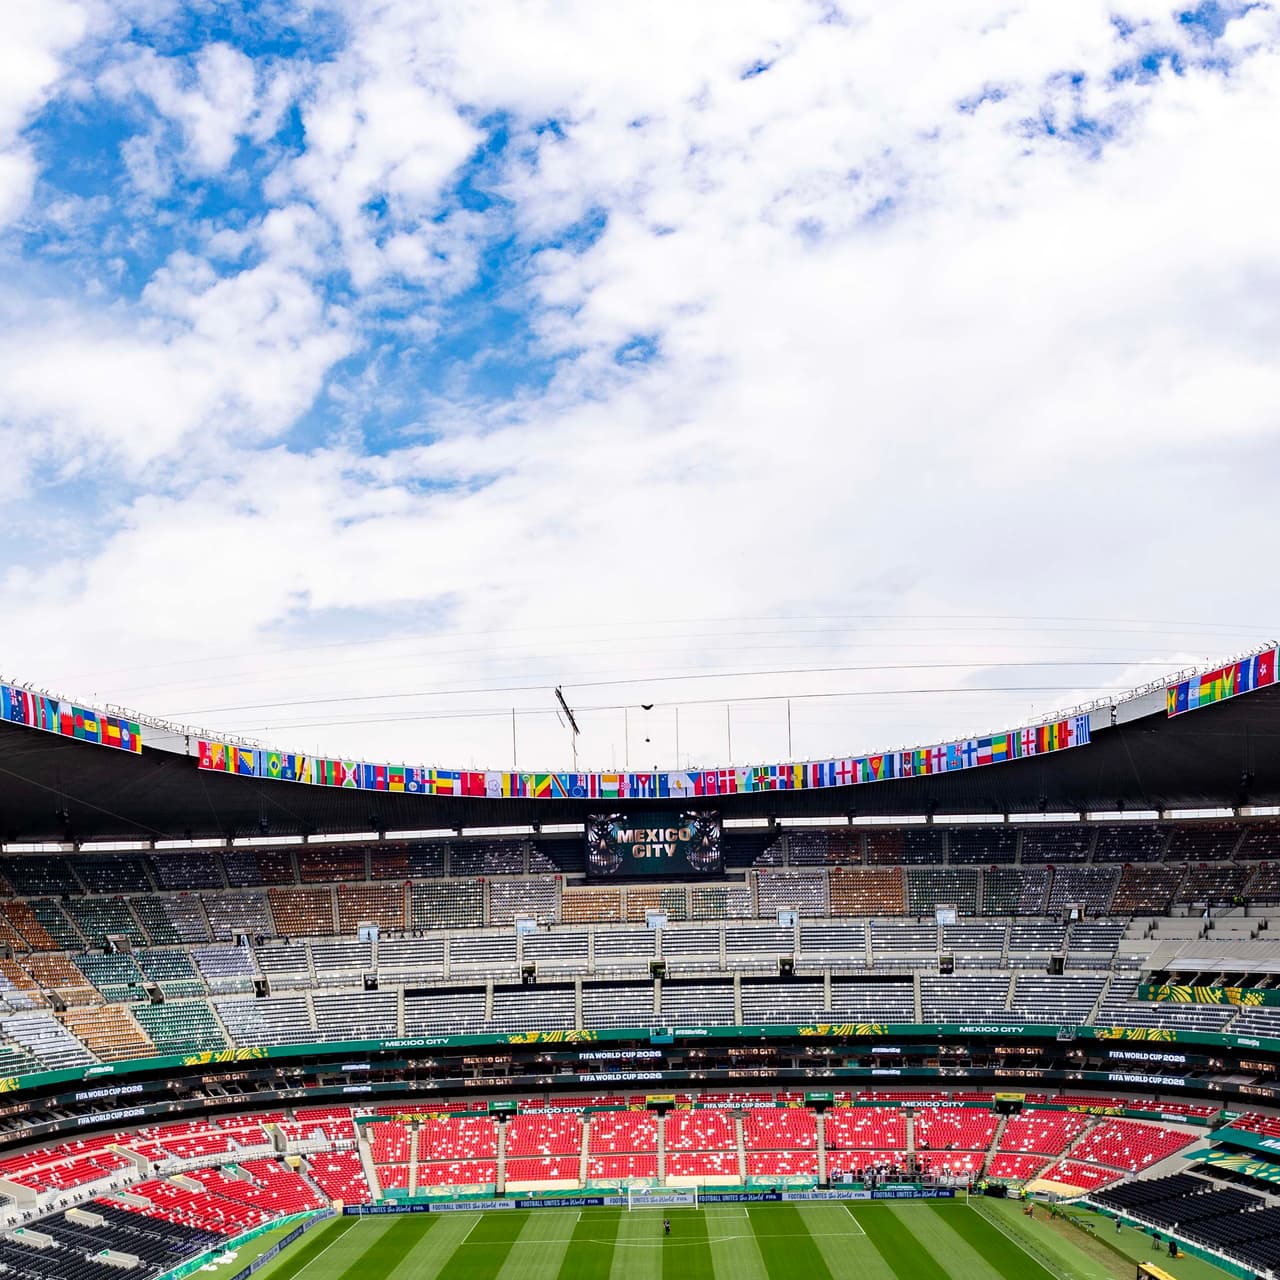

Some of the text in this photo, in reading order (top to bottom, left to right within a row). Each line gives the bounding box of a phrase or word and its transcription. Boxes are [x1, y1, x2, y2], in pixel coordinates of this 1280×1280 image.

[617, 828, 691, 843] MEXICO
[632, 844, 676, 858] CITY
[959, 1026, 998, 1034] MEXICO
[385, 1038, 449, 1047] MEXICO CITY
[579, 1052, 594, 1060] FIFA
[617, 1051, 636, 1059] CUP
[637, 1050, 662, 1058] 2026
[728, 1048, 778, 1056] MEXICO CITY
[994, 1047, 1044, 1055] MEXICO CITY
[1109, 1051, 1186, 1063] FIFA WORLD CUP 2026
[75, 1084, 143, 1100] FIFA WORLD CUP 2026
